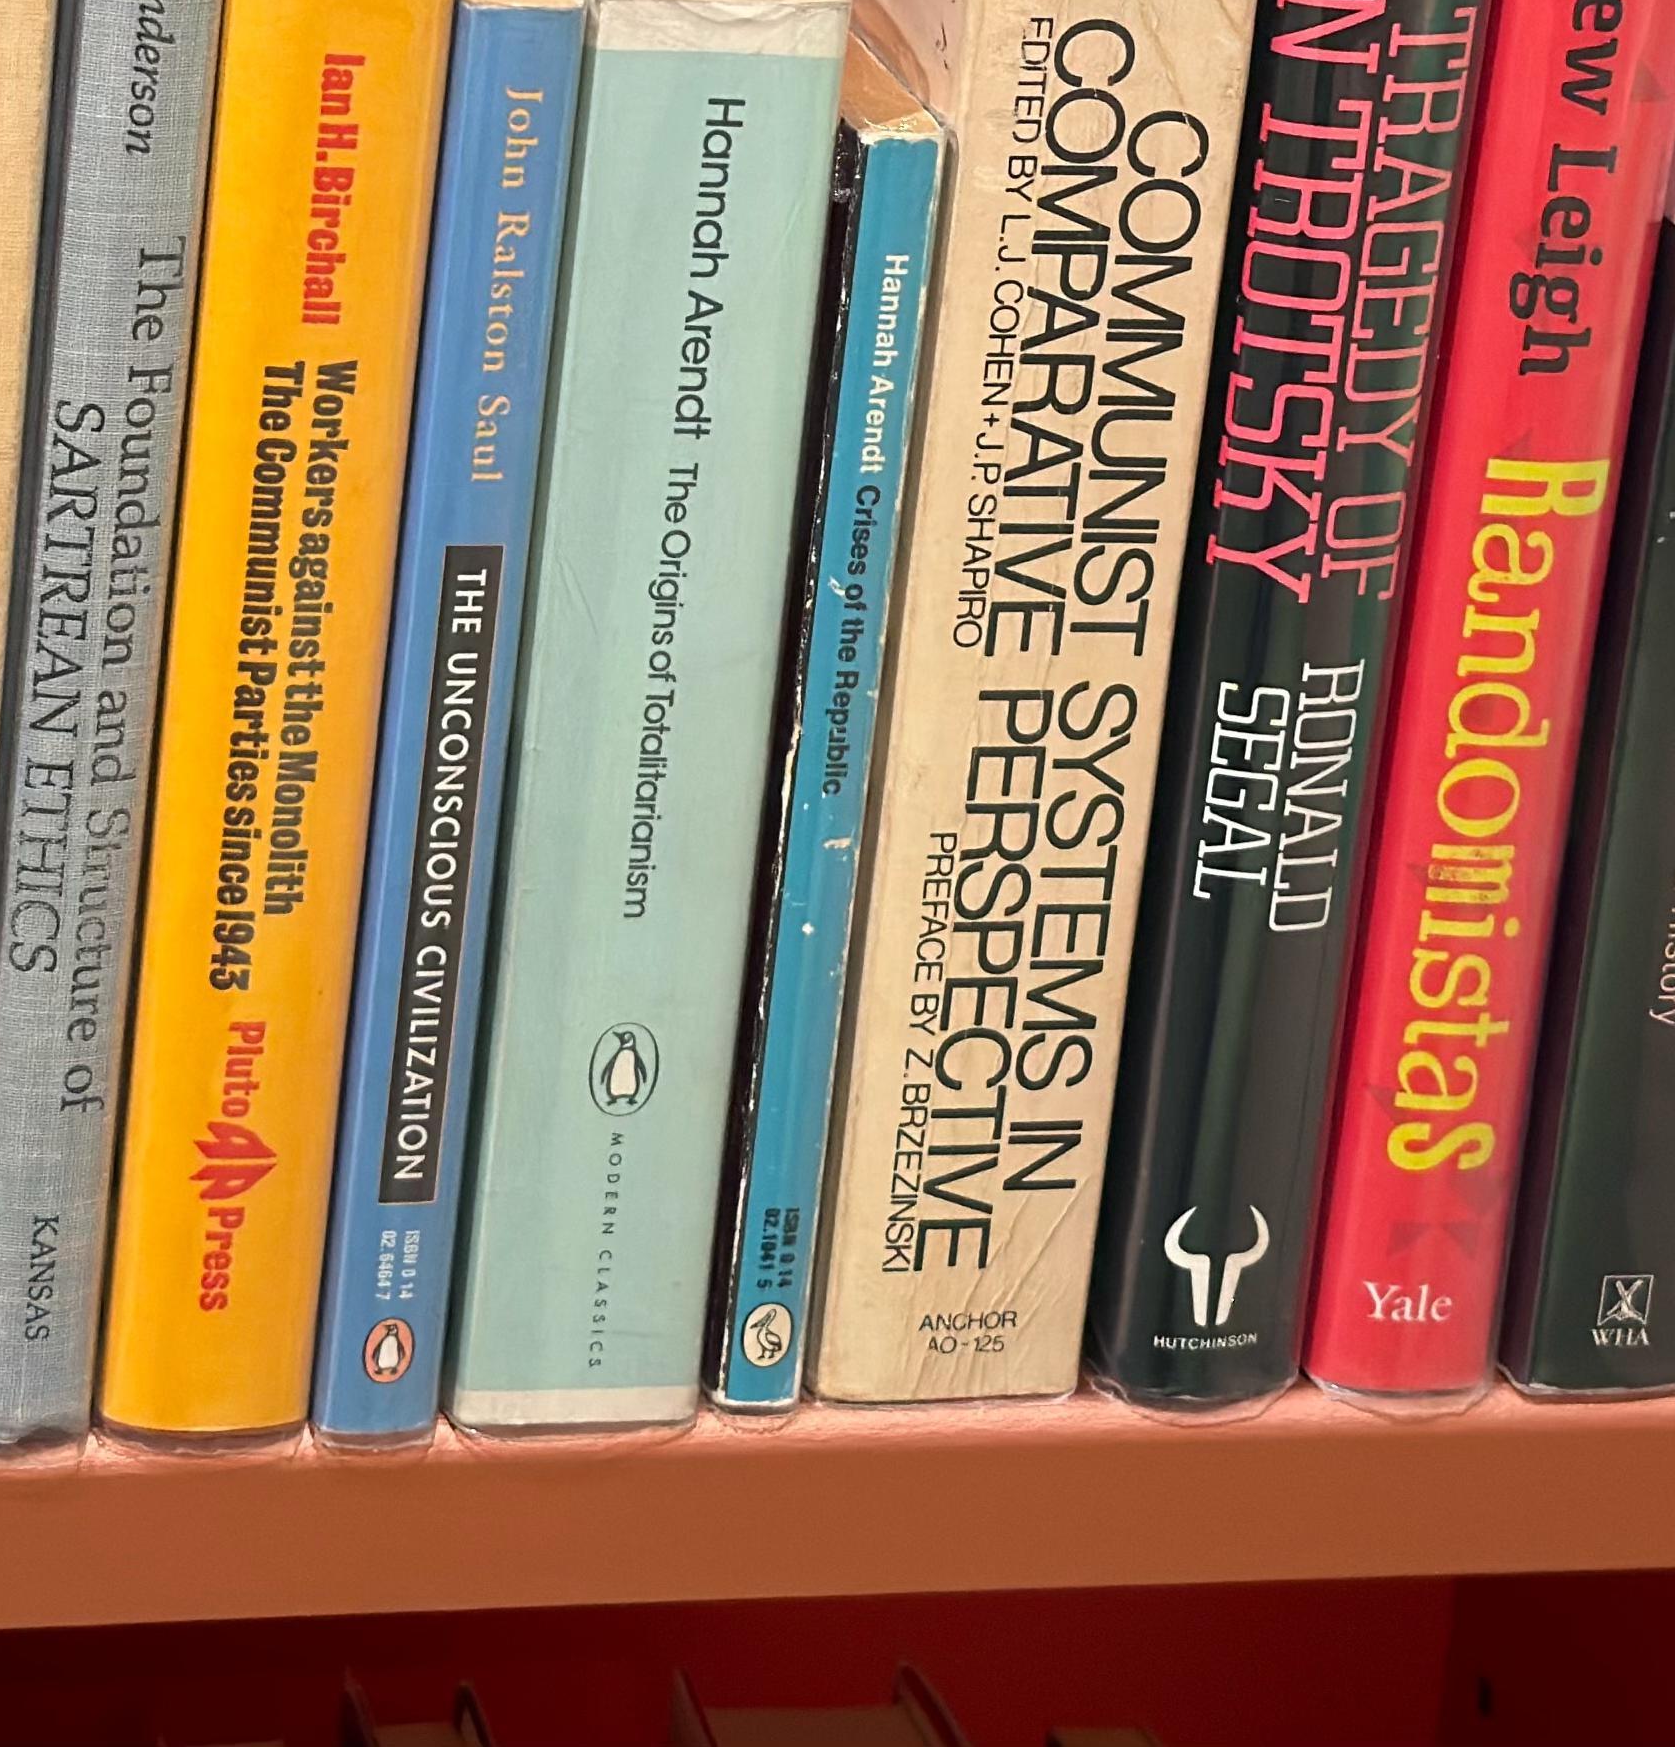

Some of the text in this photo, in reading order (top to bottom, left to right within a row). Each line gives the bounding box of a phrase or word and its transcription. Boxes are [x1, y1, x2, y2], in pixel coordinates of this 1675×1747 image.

[319, 52, 365, 115] Ian
[130, 235, 187, 341] The
[471, 86, 543, 483] John Ralston Saul
[1206, 99, 1372, 604] TROTSKY
[1335, 6, 1476, 467] TRAGEDY
[1508, 143, 1618, 377] Leigh
[105, 364, 173, 666] Foundation
[1322, 493, 1407, 602] OF
[10, 401, 105, 973] SARTREAN ETHICS
[88, 690, 134, 780] and
[913, 18, 1135, 1272] COMPARATIVE PERSPECTIVE
[1001, 109, 1209, 1191] COMMUNIST SYSTEMS IN
[395, 567, 487, 1183] THE UNCONSCIOUS CIVILIZATION
[1192, 681, 1291, 899] SEGAL
[1270, 658, 1365, 932] RONALD
[1386, 458, 1611, 1171] Randomistas
[64, 808, 134, 1048] Structure
[61, 1059, 105, 1113] of
[24, 1214, 60, 1340] KANSAS
[588, 1132, 623, 1370] MODERN CLASSICS
[918, 1310, 1018, 1333] ANCHOR
[1153, 1331, 1258, 1352] HUTCHINSON
[1362, 1280, 1454, 1324] Yale
[1592, 1327, 1649, 1346] WHA
